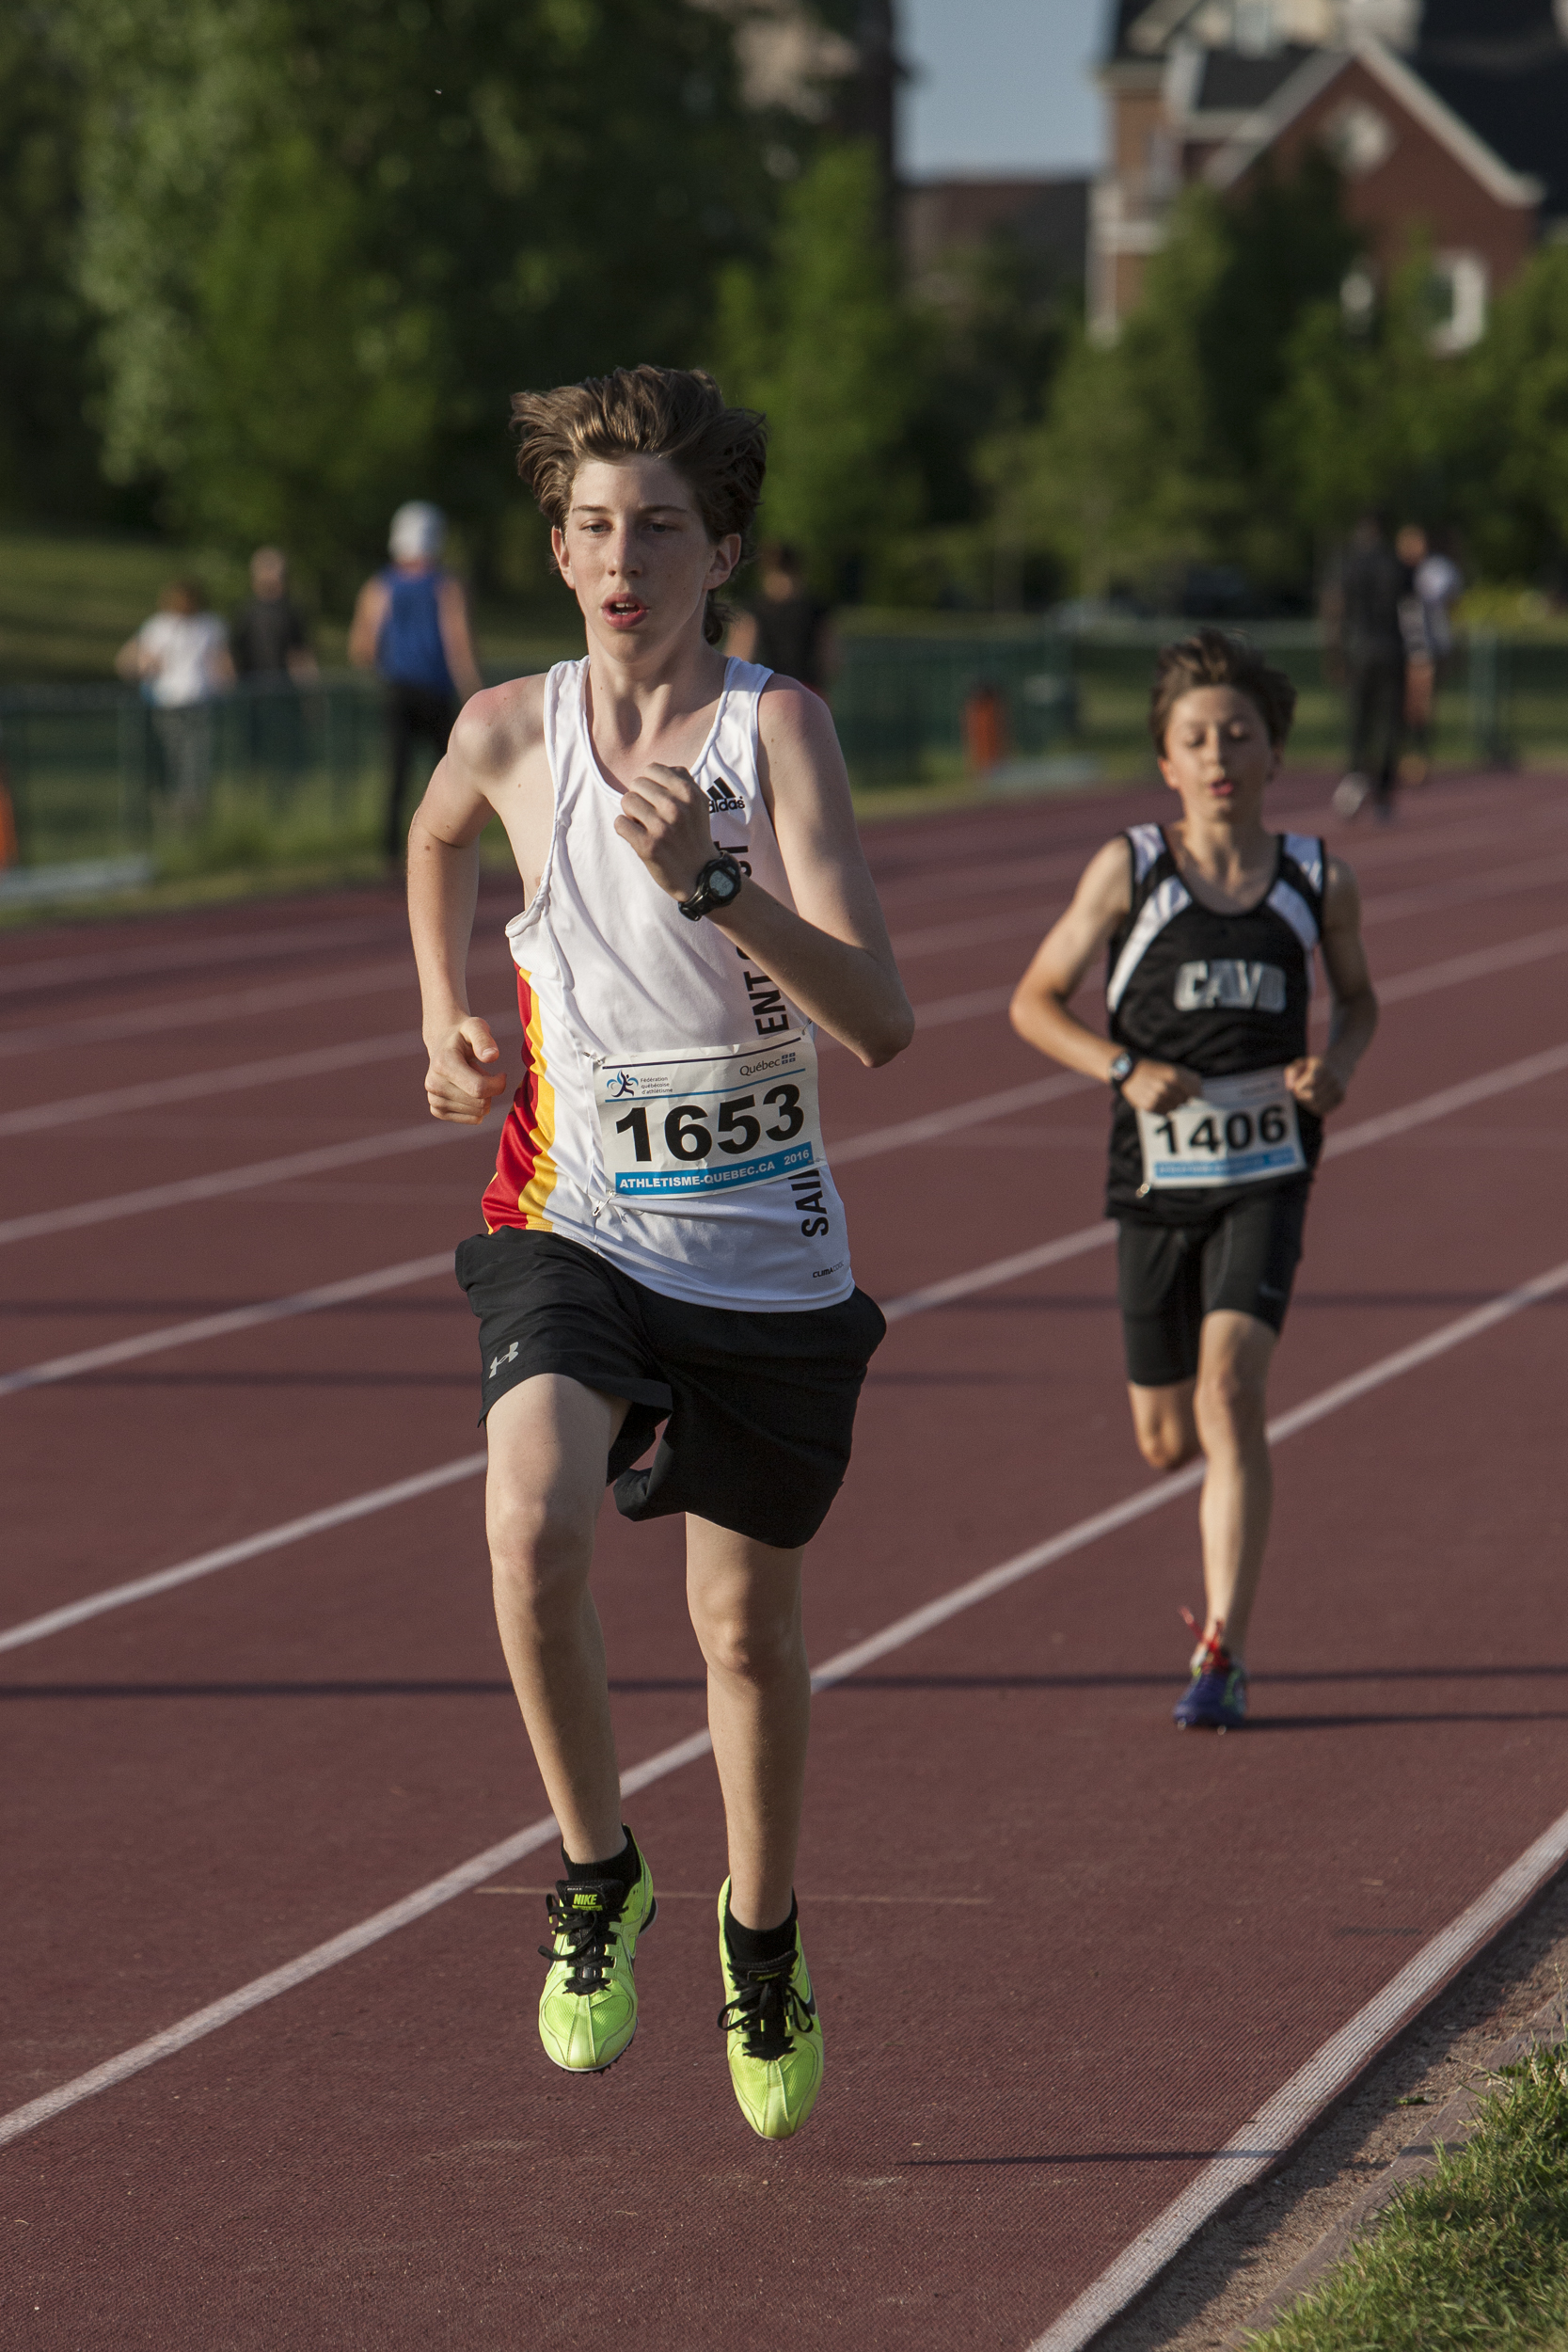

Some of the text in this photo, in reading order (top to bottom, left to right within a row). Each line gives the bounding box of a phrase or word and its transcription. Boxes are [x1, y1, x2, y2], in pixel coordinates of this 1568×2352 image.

[707, 797, 745, 814] didas
[739, 1057, 781, 1076] Québec
[616, 1084, 805, 1163] 1653
[1155, 1104, 1287, 1156] 1406
[619, 1149, 810, 1189] ATHLETISME-QUEBEC.CA 2016
[574, 1893, 598, 1905] NIKE
